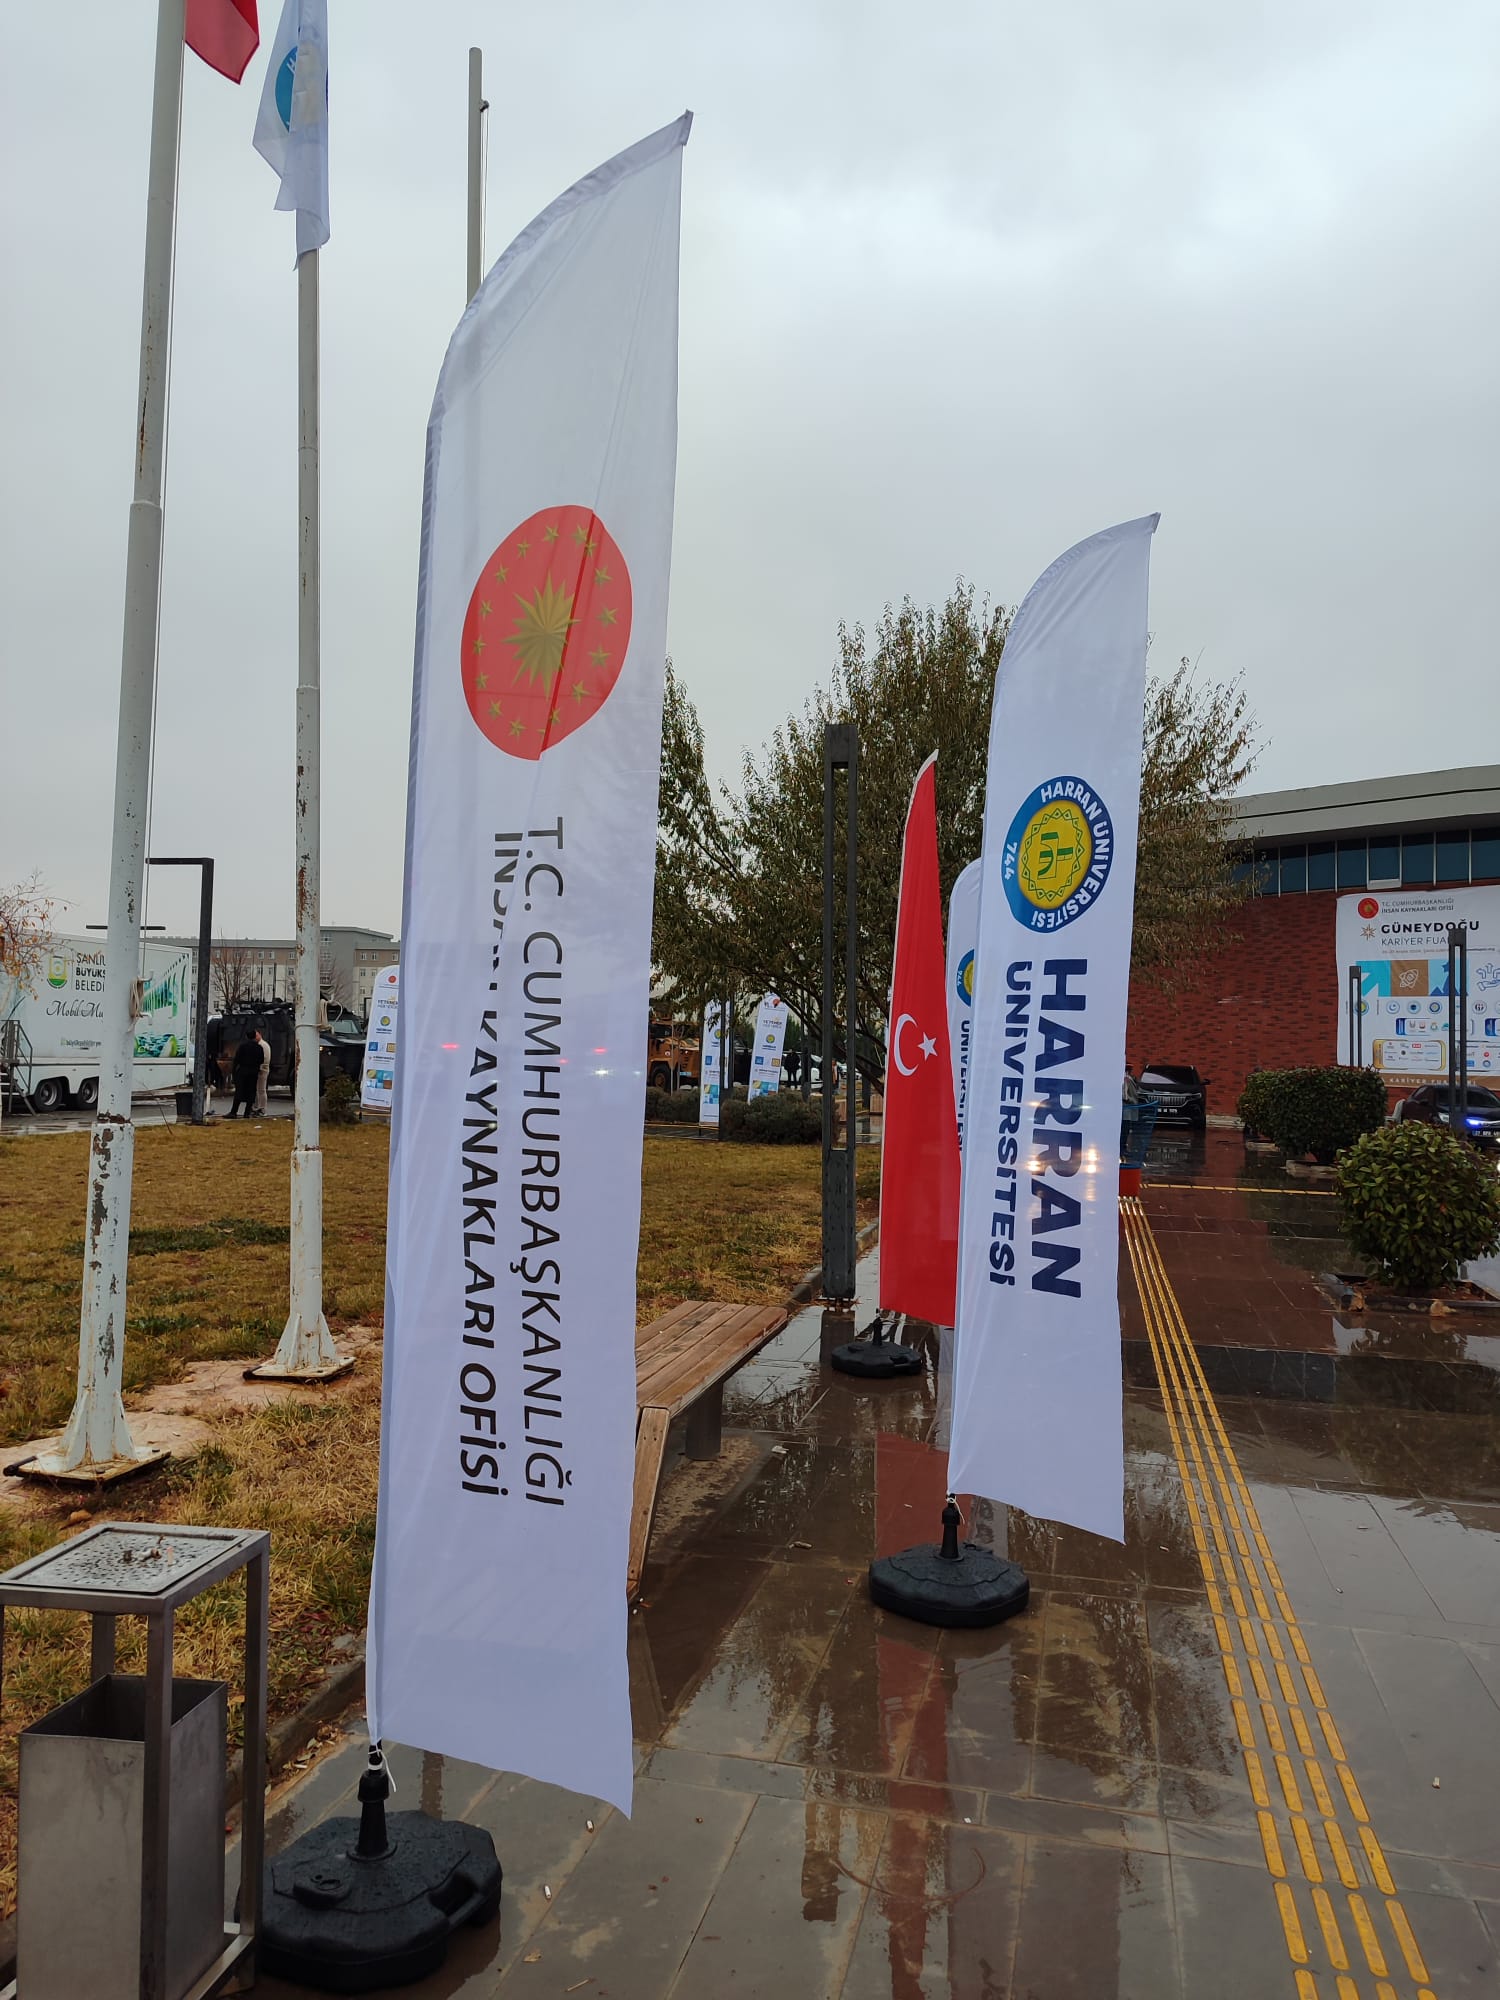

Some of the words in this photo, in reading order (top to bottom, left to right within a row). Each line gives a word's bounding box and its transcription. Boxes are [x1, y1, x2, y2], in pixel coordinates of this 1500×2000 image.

[1041, 780, 1102, 821] HARRAN
[525, 816, 563, 911] T.C.
[1004, 841, 1018, 881] 744
[1031, 820, 1109, 929] ÜNİVERSİTESİ
[1381, 919, 1479, 934] GÜNEYDOĞU
[1381, 937, 1423, 946] KARİYER
[1426, 936, 1449, 945] FUA
[75, 980, 105, 992] BELEDİ
[989, 961, 1033, 1287] ÜNİVERSİTESİ
[1030, 958, 1088, 1299] HARRAN
[510, 931, 572, 1506] CUMHURBAŞKANLIĞI
[460, 1362, 509, 1495] OFİSİ
